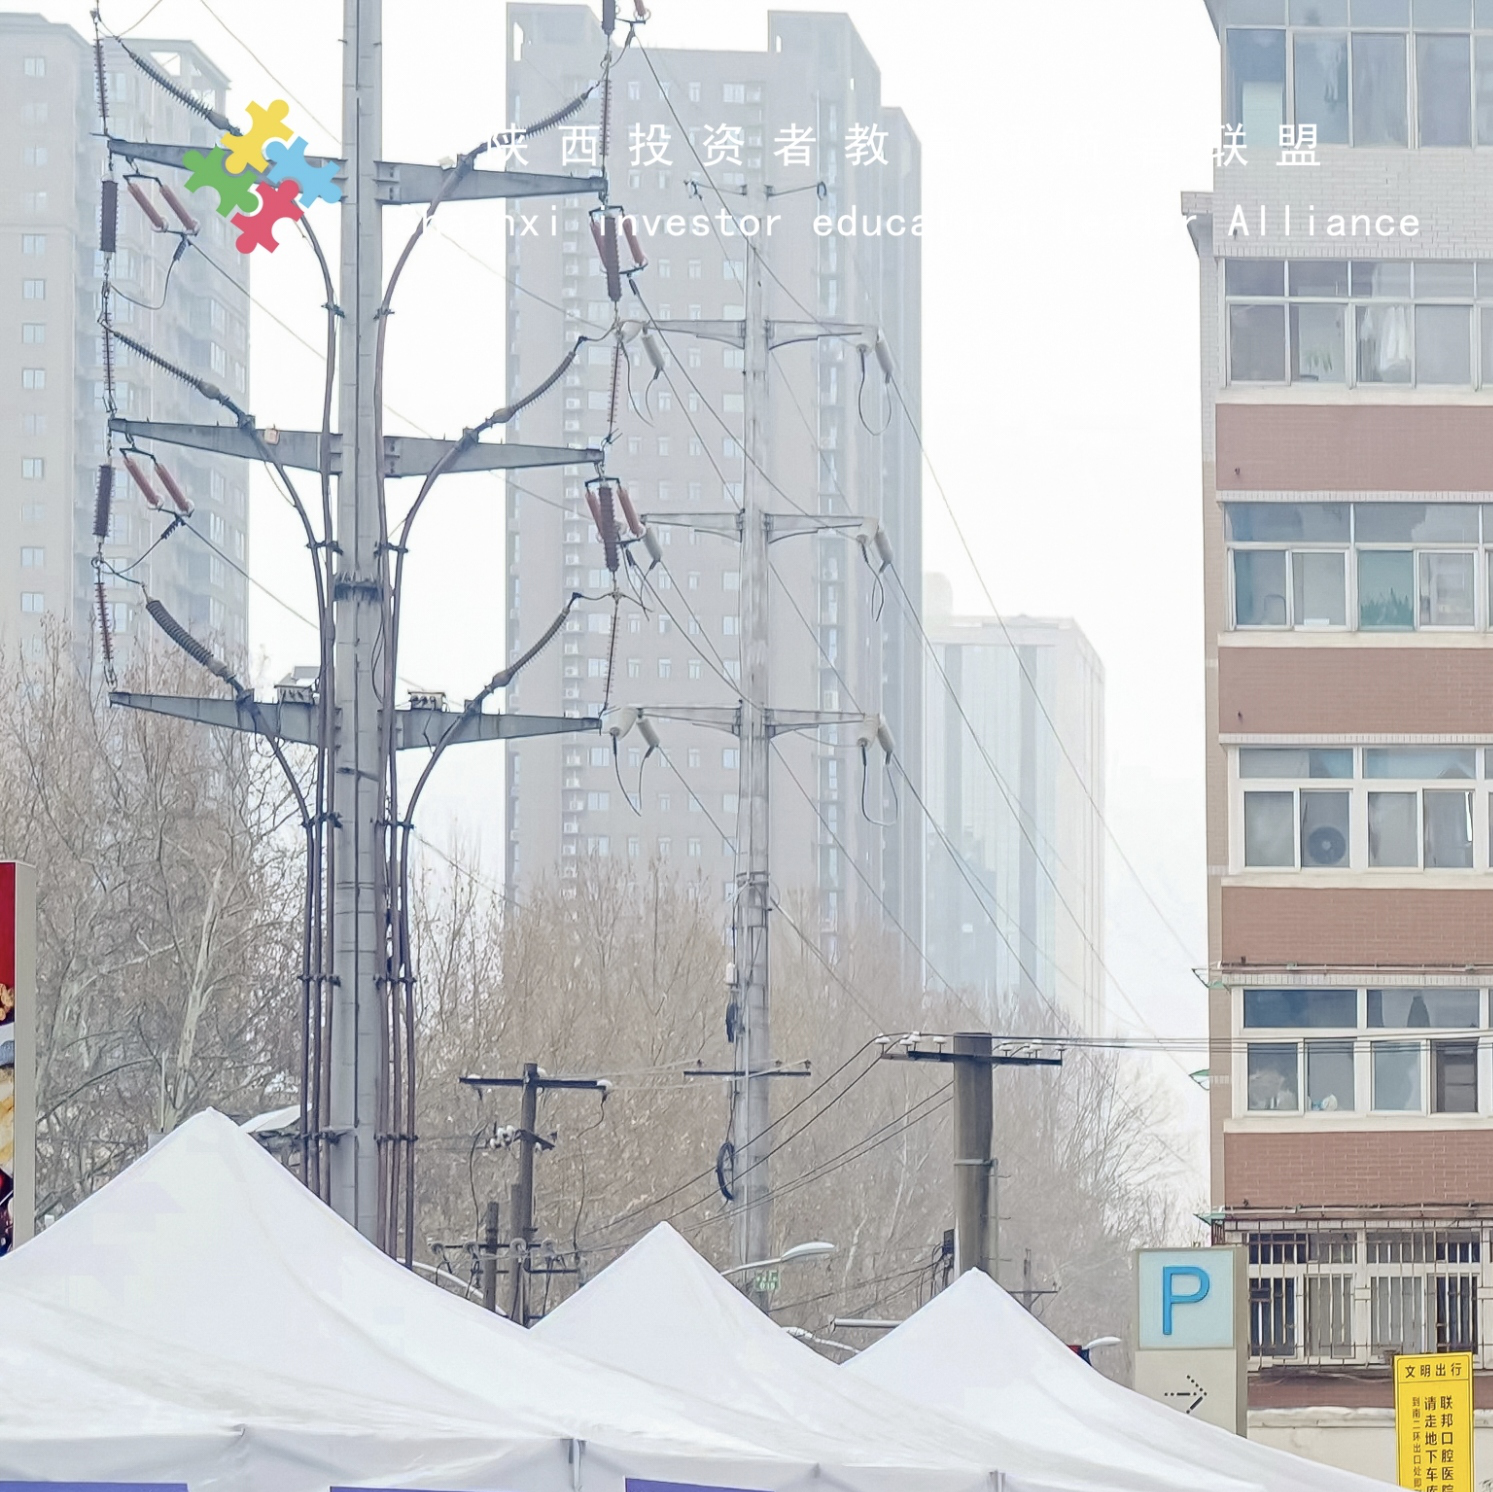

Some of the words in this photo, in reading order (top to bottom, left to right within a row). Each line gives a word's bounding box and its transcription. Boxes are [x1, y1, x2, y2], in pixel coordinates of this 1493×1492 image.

[1162, 1265, 1210, 1336] P
[1405, 1362, 1462, 1379] 文明出行
